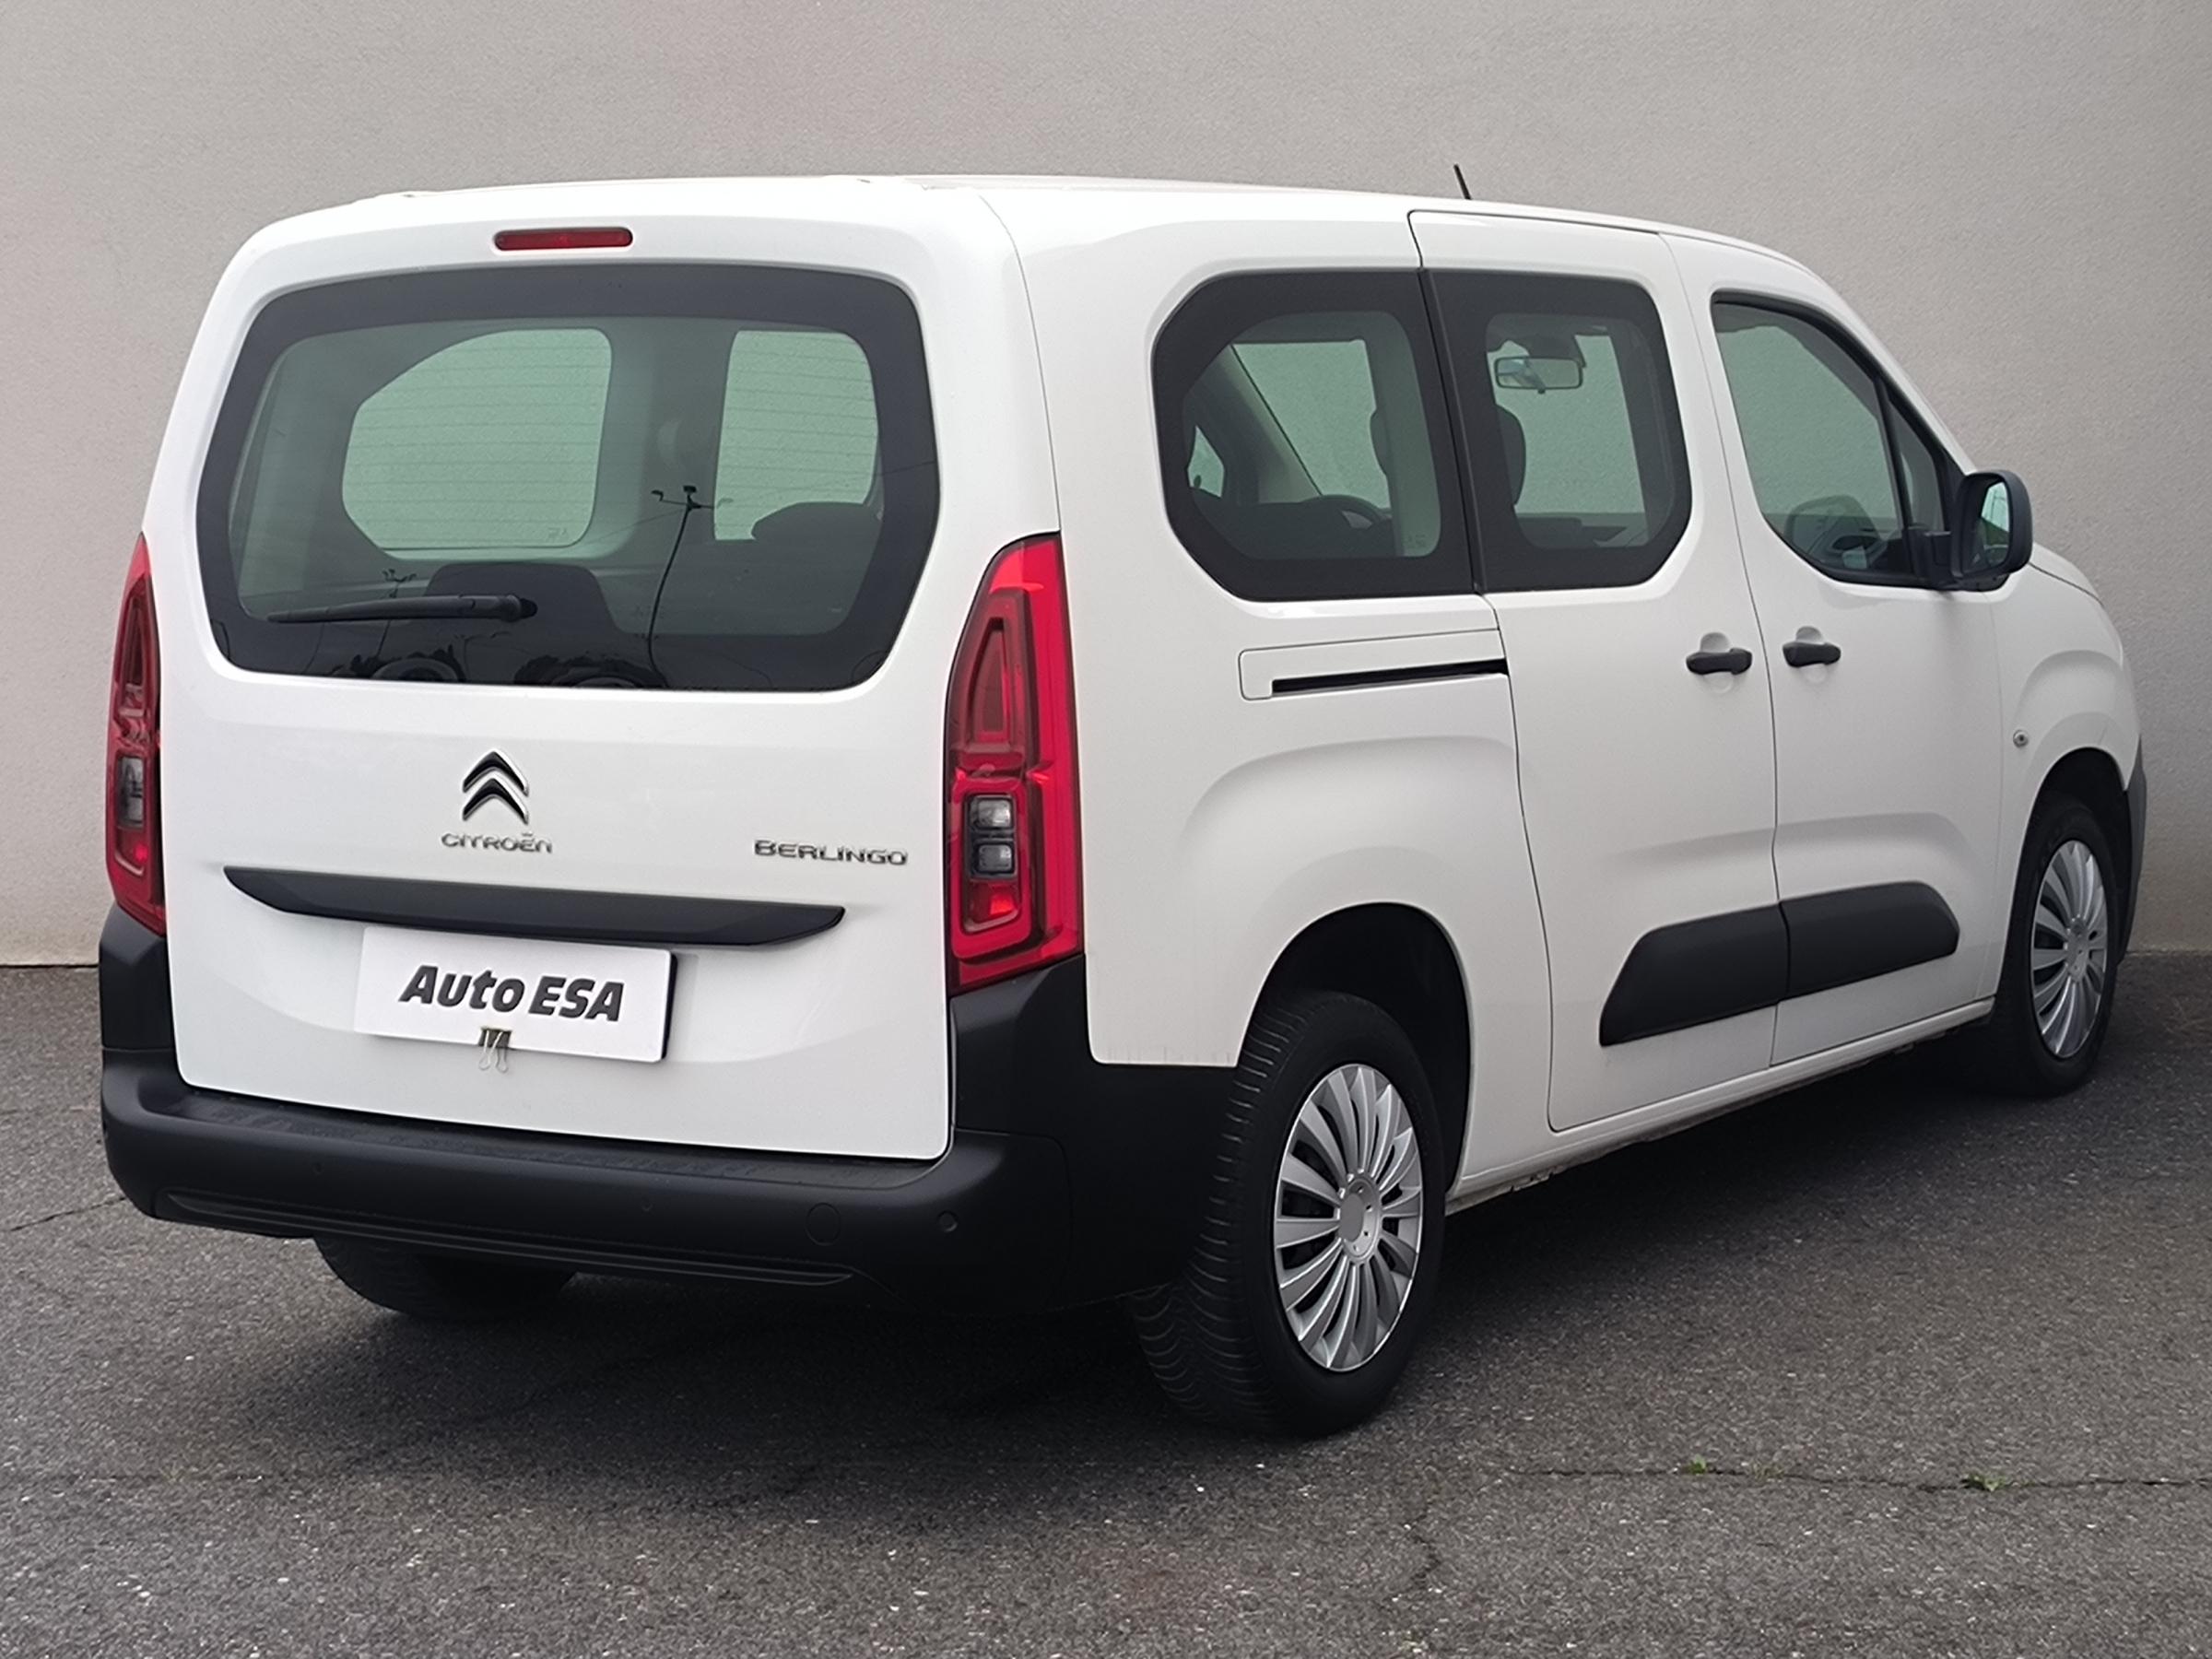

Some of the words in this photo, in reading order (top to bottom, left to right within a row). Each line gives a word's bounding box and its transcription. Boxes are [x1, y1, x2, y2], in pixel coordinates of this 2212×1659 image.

[441, 832, 552, 853] CITROËN
[755, 840, 908, 865] BERLINGO
[398, 965, 525, 1013] Auto
[528, 976, 625, 1022] ESA
